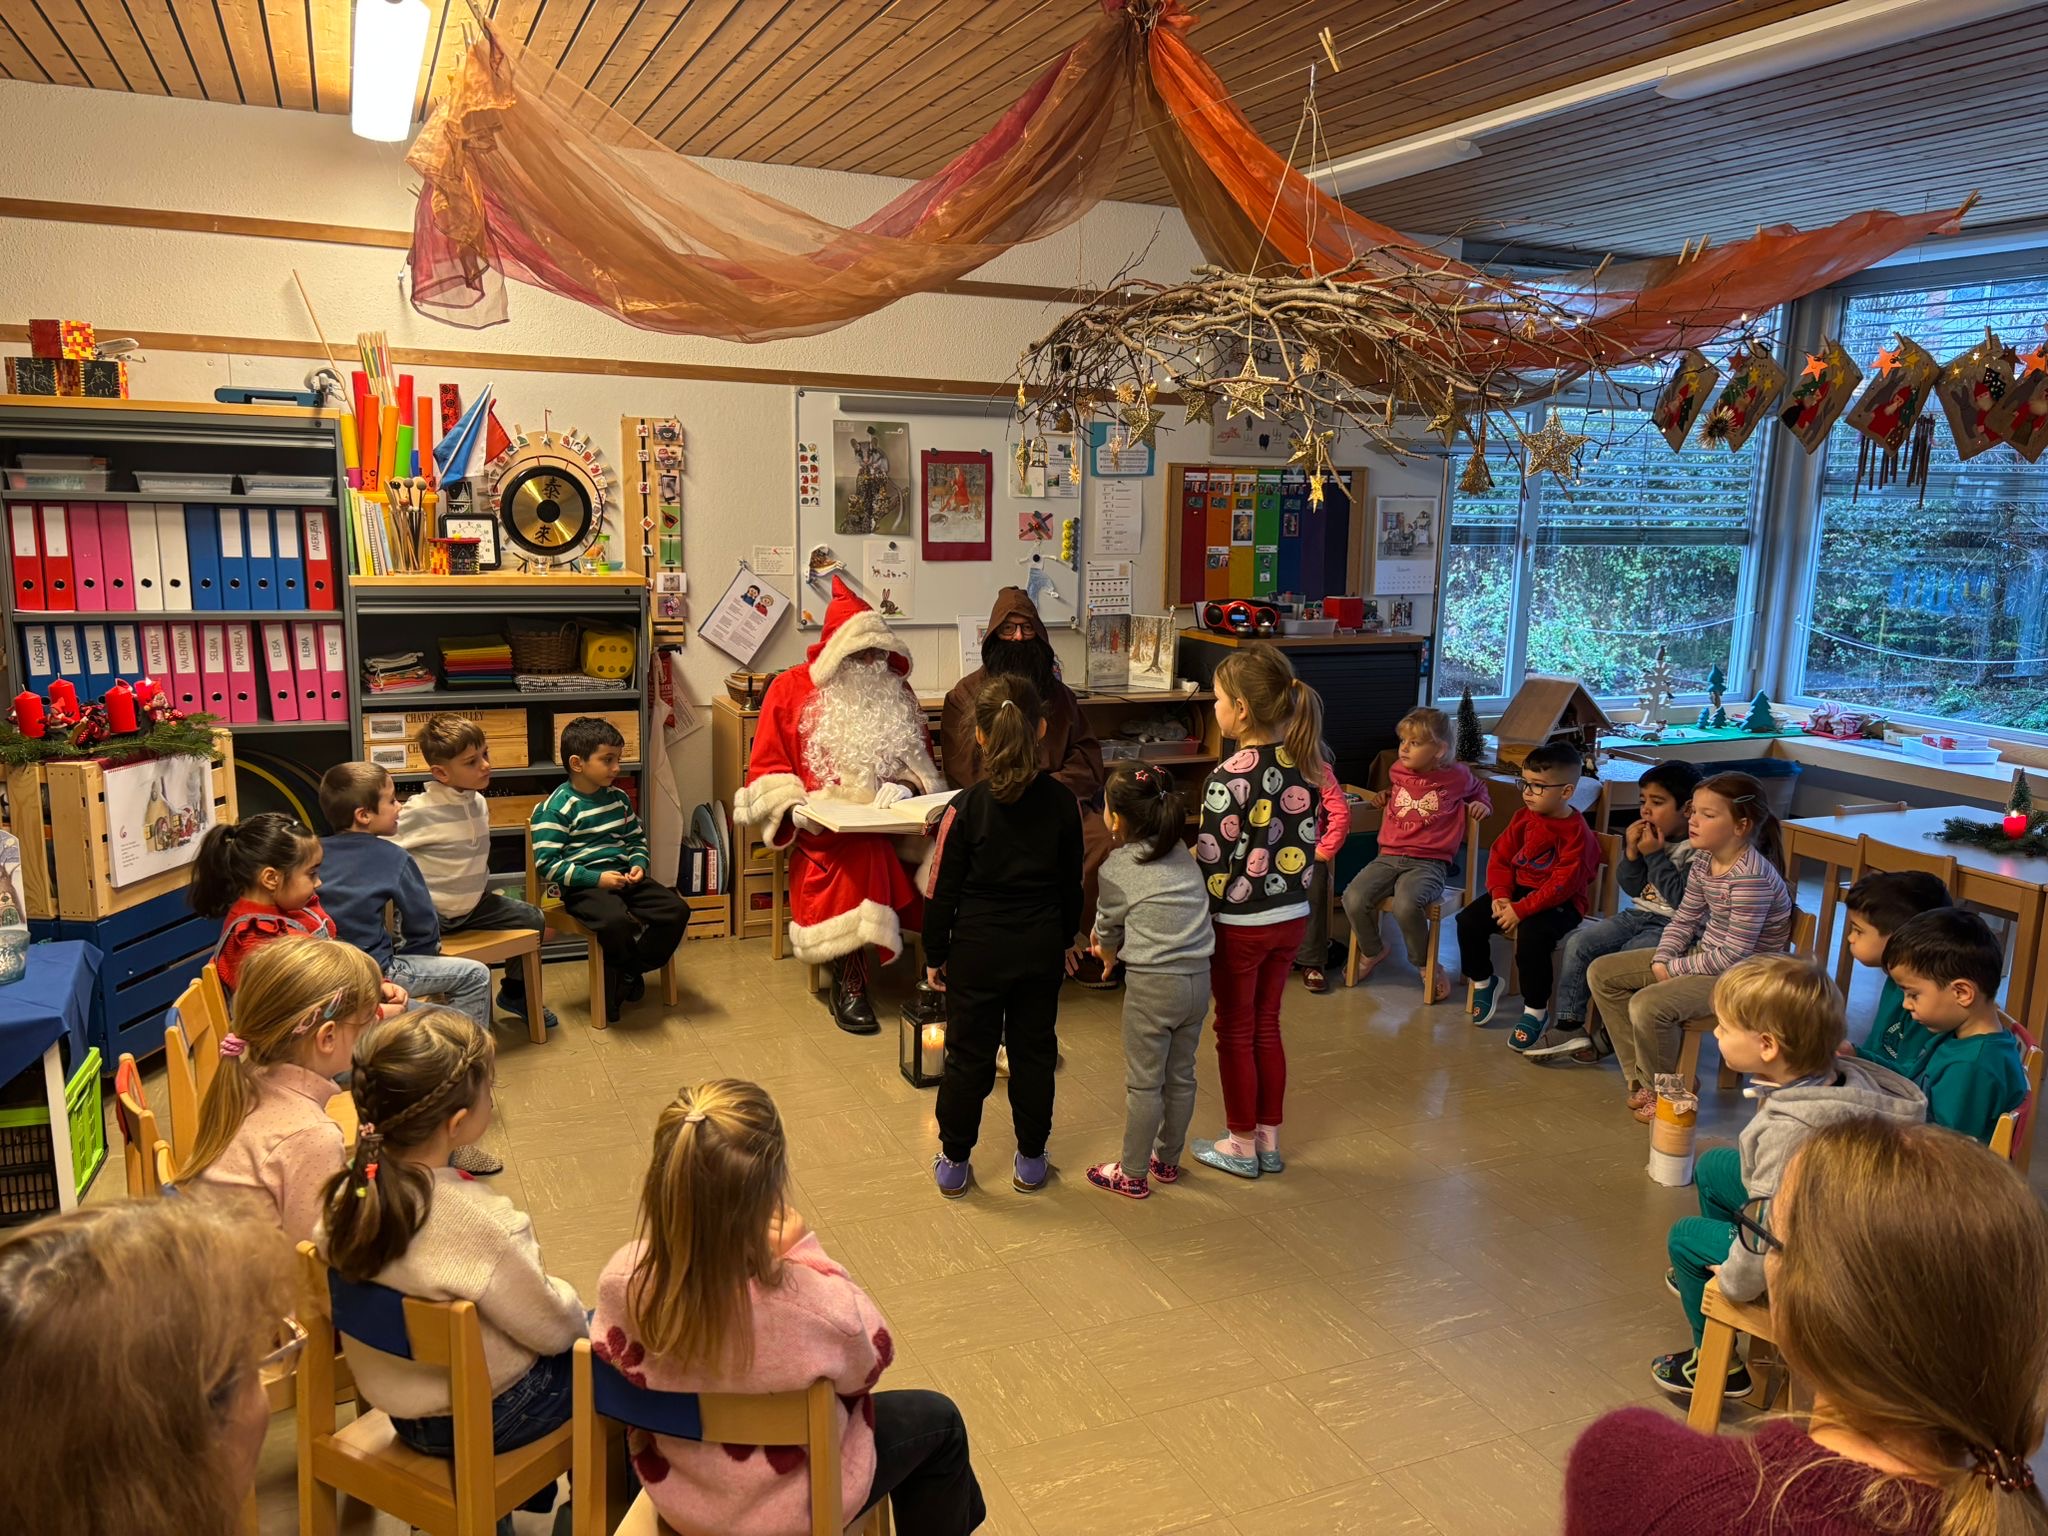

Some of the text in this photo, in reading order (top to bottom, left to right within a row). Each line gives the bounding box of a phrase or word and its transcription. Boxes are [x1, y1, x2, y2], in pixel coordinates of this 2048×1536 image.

[91, 640, 103, 662] NOAH
[121, 636, 132, 661] SIMON
[150, 633, 161, 666] MATILDA
[177, 630, 189, 669] VALENTINA
[209, 637, 219, 661] SELINA
[234, 630, 245, 666] RAPHAELA
[405, 712, 437, 723] CHATE
[120, 824, 128, 839] 6
